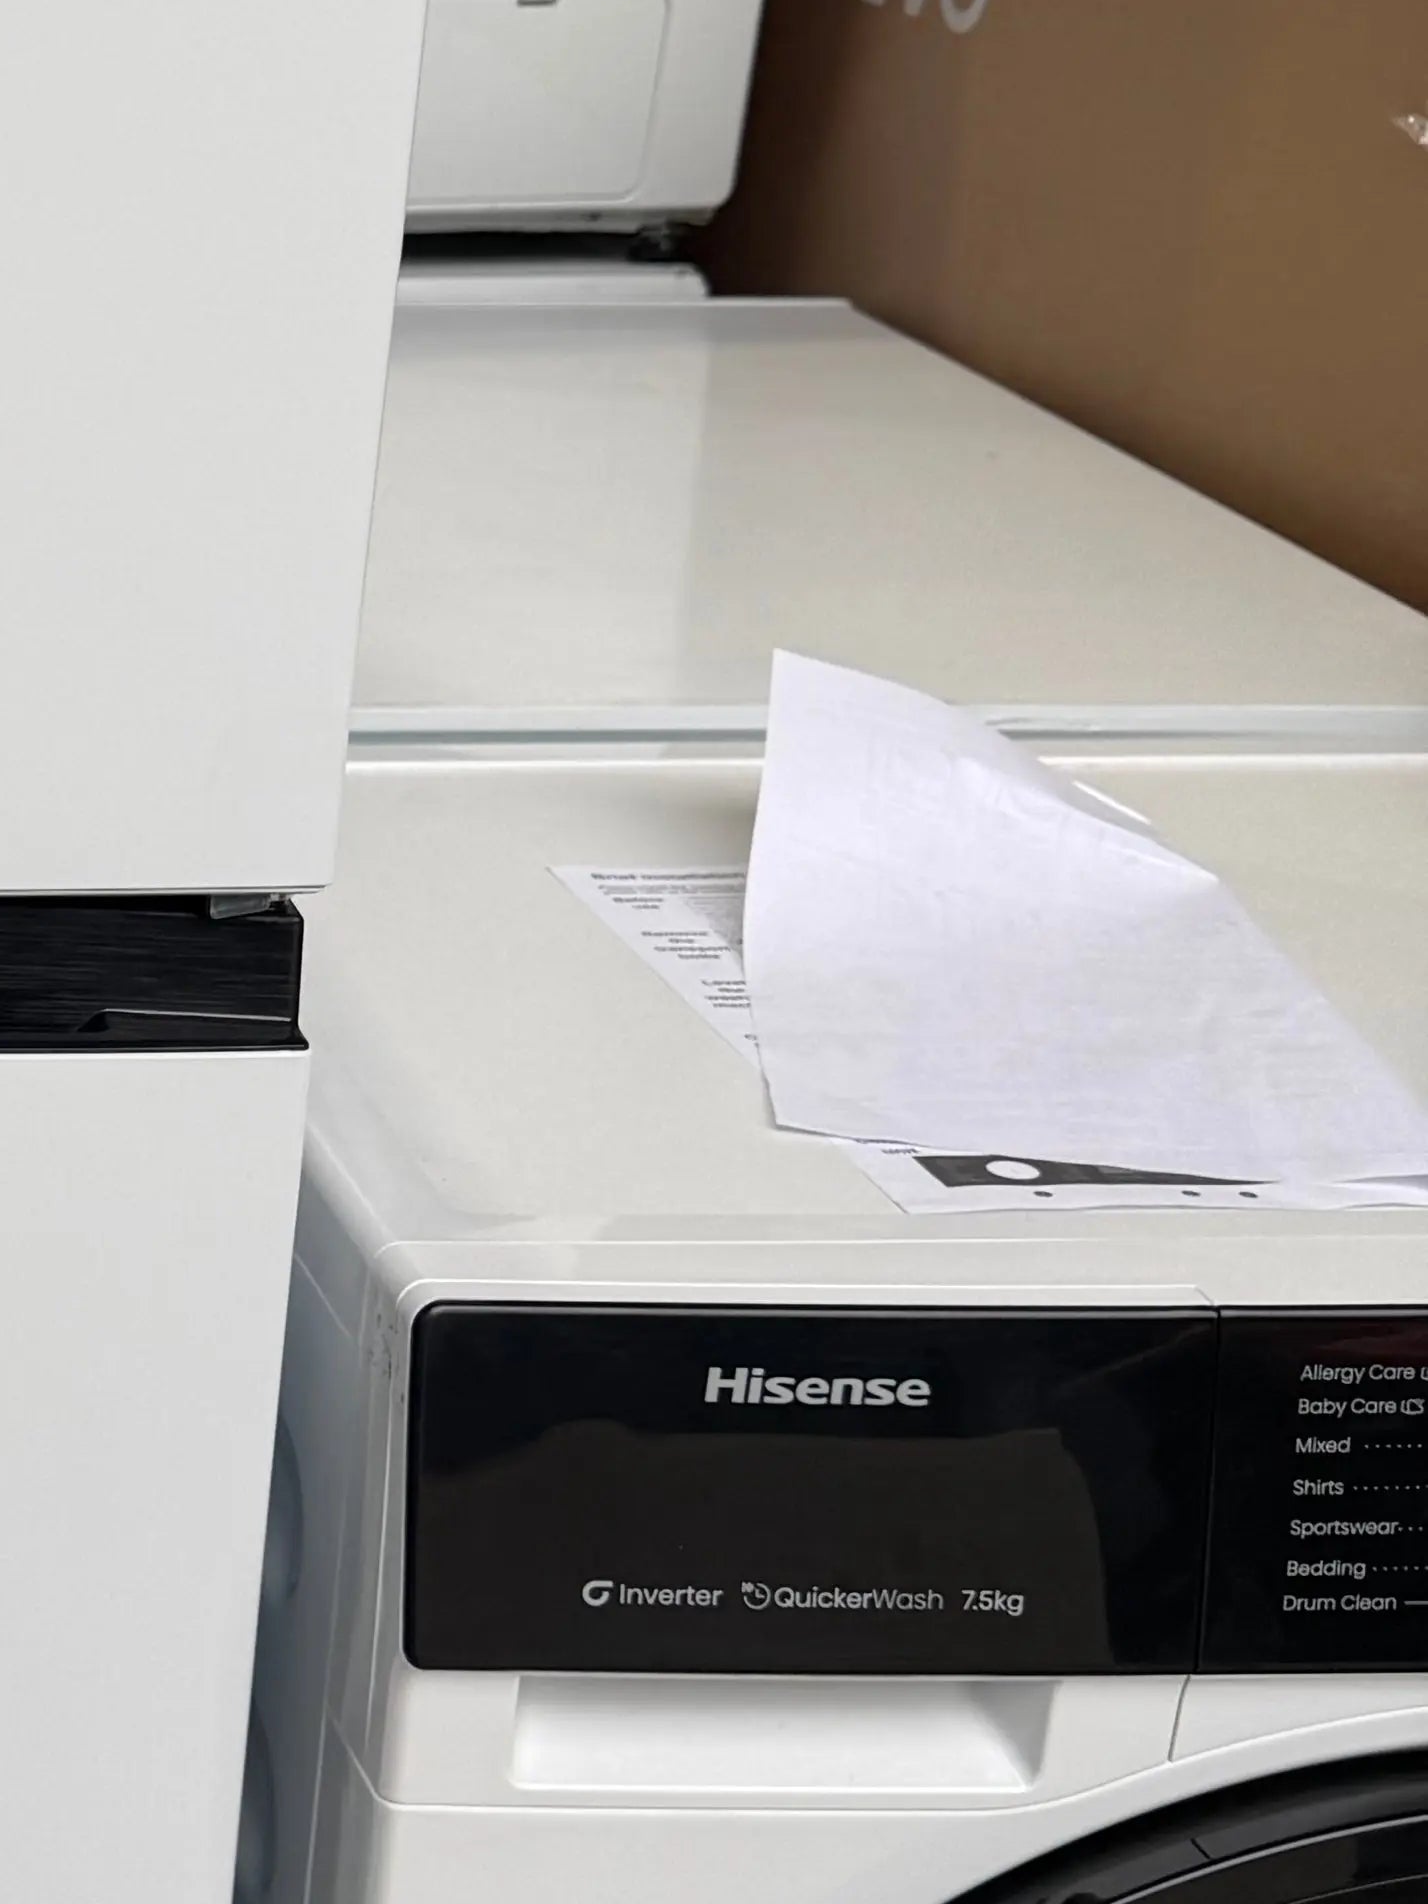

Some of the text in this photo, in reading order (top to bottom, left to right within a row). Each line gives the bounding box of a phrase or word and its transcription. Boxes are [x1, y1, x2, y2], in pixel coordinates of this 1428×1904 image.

[1300, 1364, 1416, 1384] Allergy Care
[704, 1367, 931, 1407] Hisense
[1298, 1398, 1397, 1418] Baby Care
[1295, 1436, 1351, 1453] Mixed
[1293, 1479, 1344, 1496] Shirts
[1290, 1519, 1399, 1539] Sportswear
[1287, 1560, 1366, 1580] Bedding
[619, 1583, 723, 1607] Inverter
[774, 1585, 943, 1612] QuickerWash
[961, 1589, 1024, 1616] 7.5kg
[1283, 1594, 1397, 1611] Drum Clean
